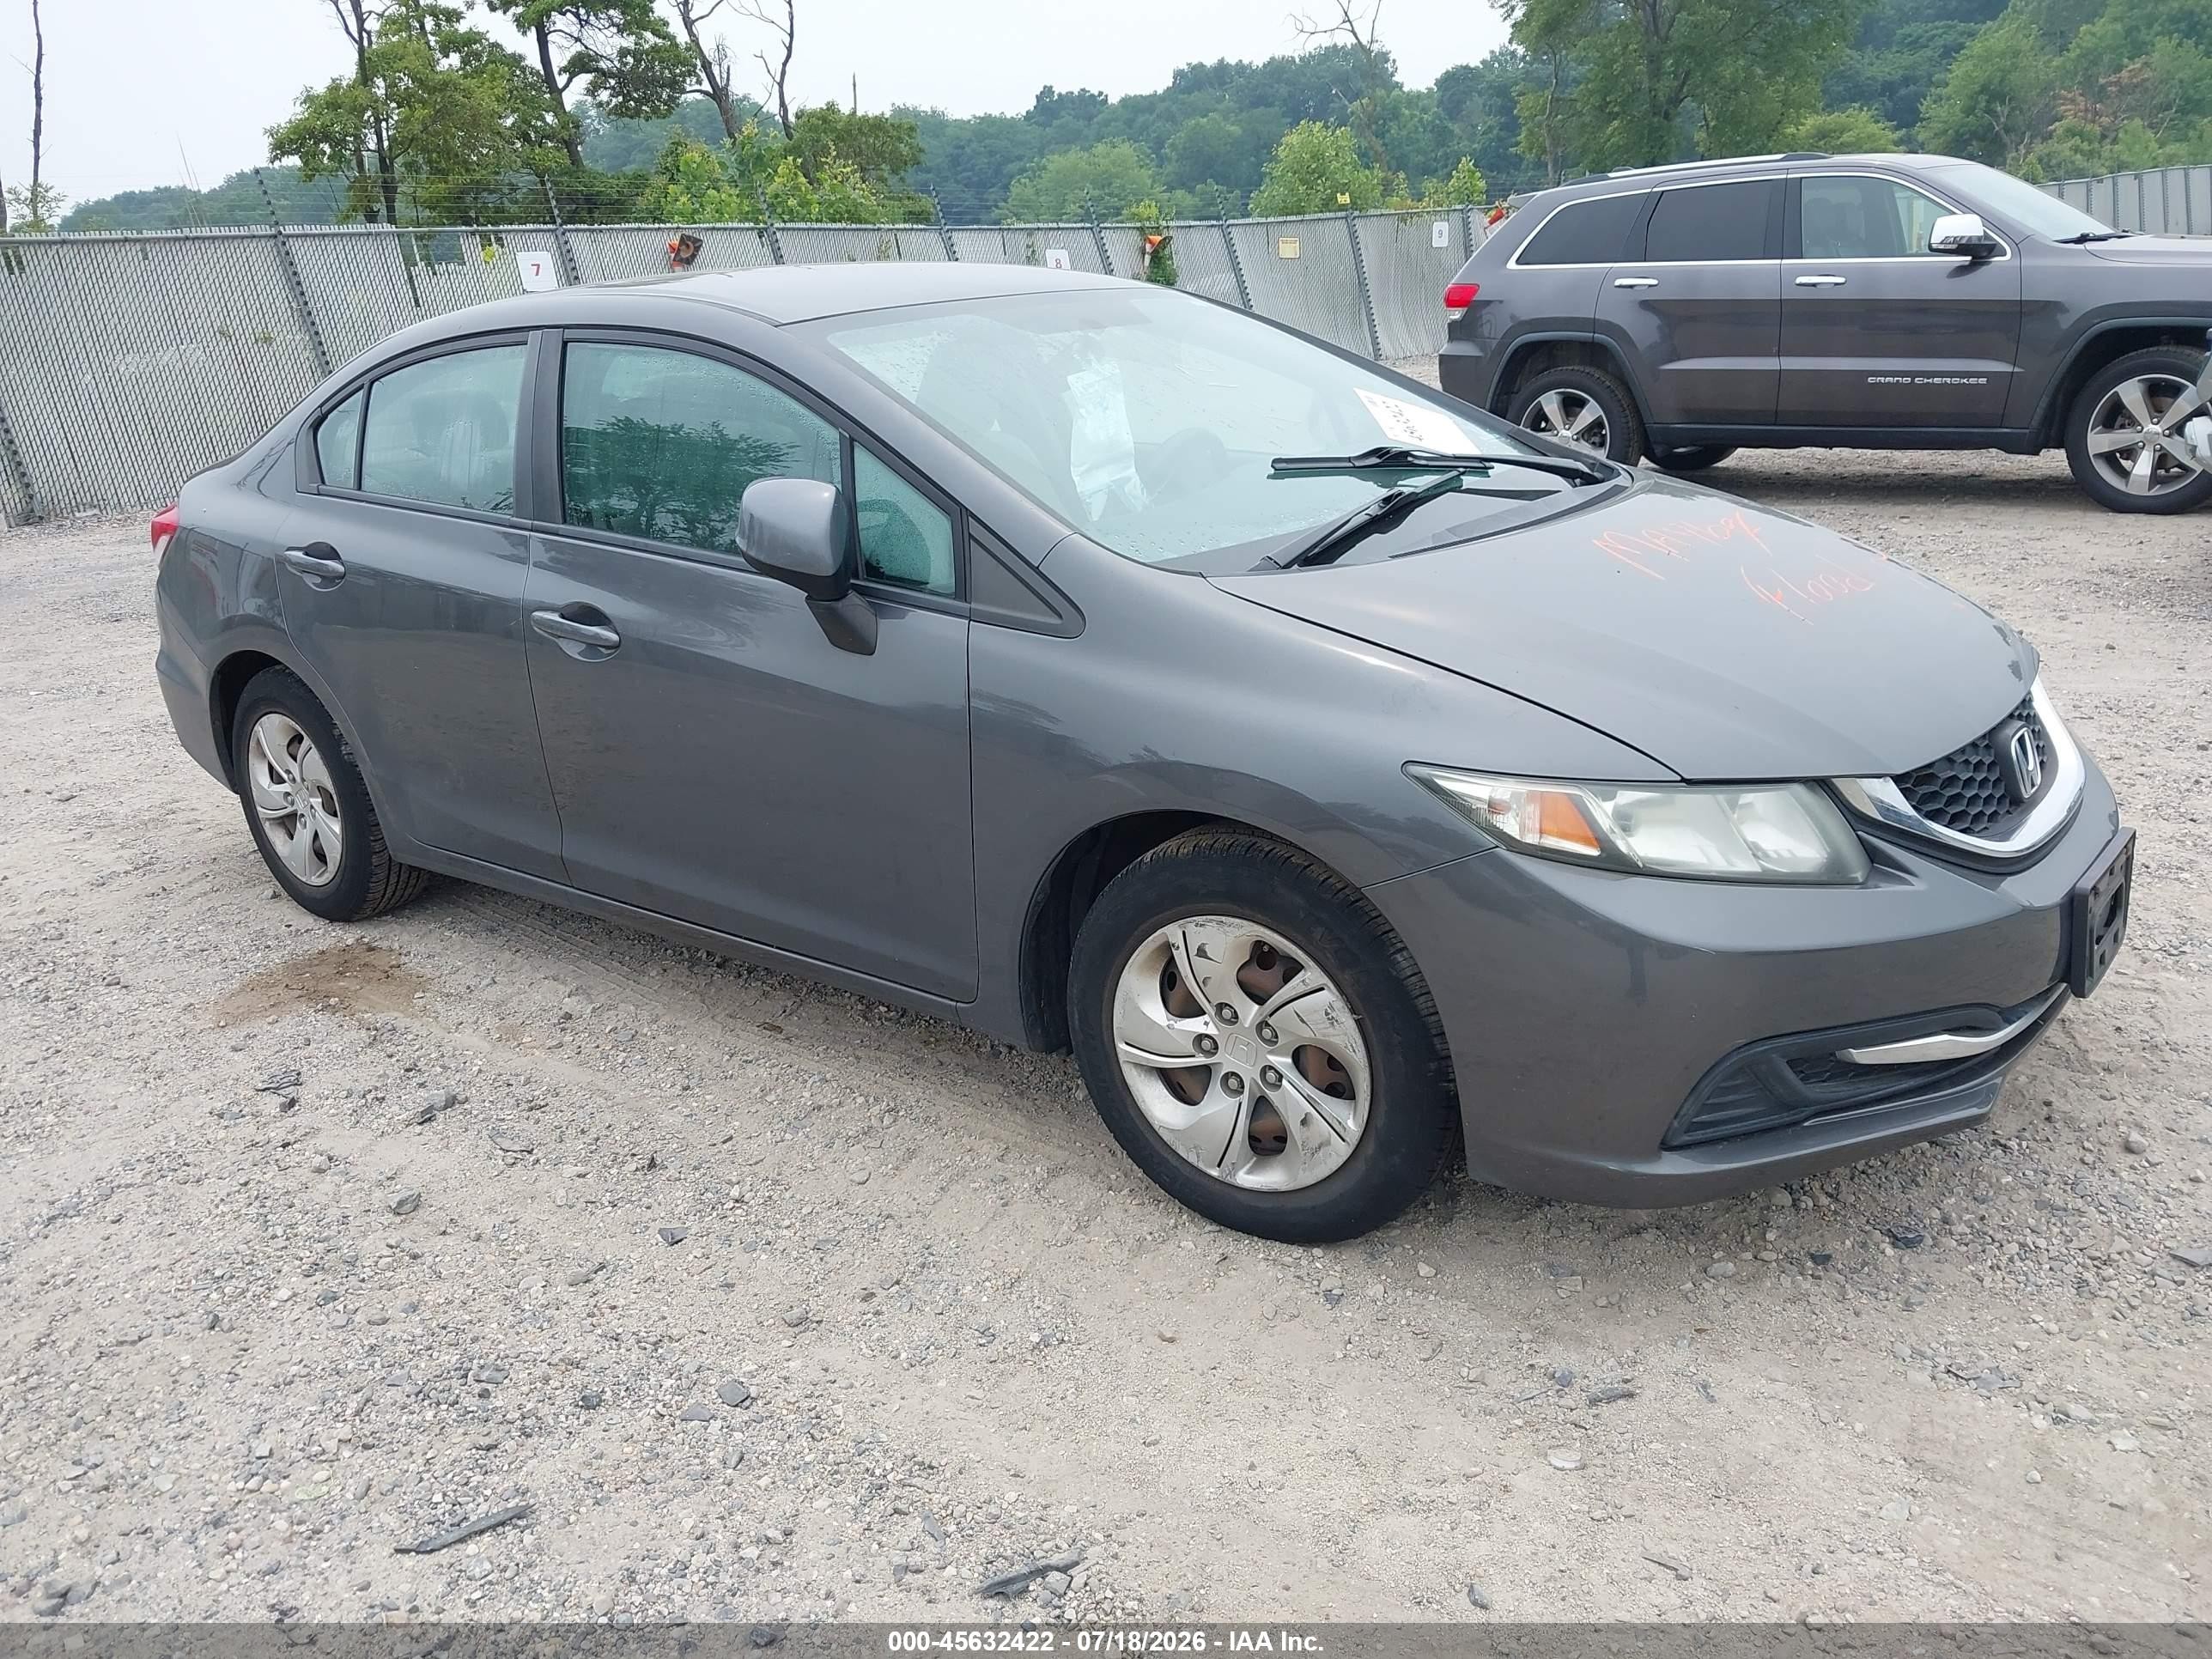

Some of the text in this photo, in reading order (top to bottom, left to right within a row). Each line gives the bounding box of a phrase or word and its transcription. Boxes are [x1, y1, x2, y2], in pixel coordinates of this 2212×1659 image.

[1437, 228, 1443, 239] 9
[1054, 258, 1062, 269] 8
[531, 263, 541, 276] 7
